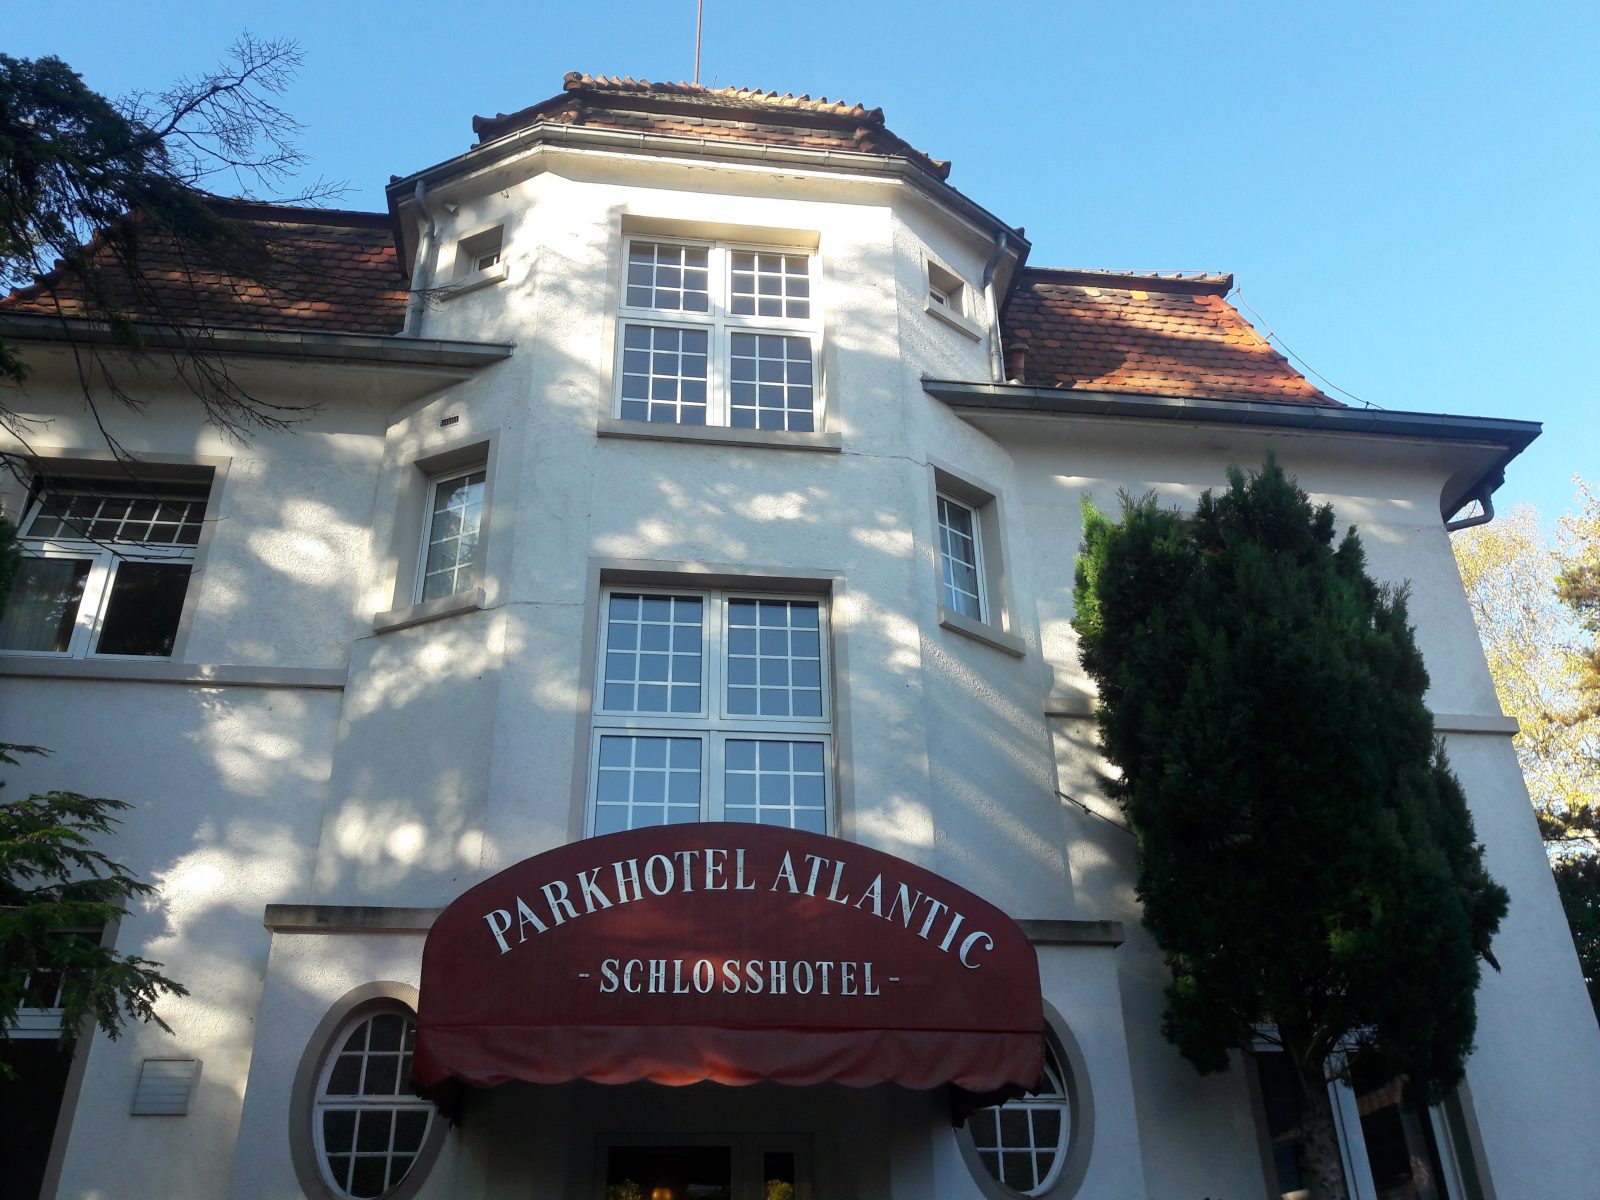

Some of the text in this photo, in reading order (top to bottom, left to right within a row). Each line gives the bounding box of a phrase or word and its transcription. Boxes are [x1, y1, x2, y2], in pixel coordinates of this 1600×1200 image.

[482, 848, 995, 970] PARKHOTEL ATLANTIC
[599, 958, 881, 996] SCHLOSSHOTEL
